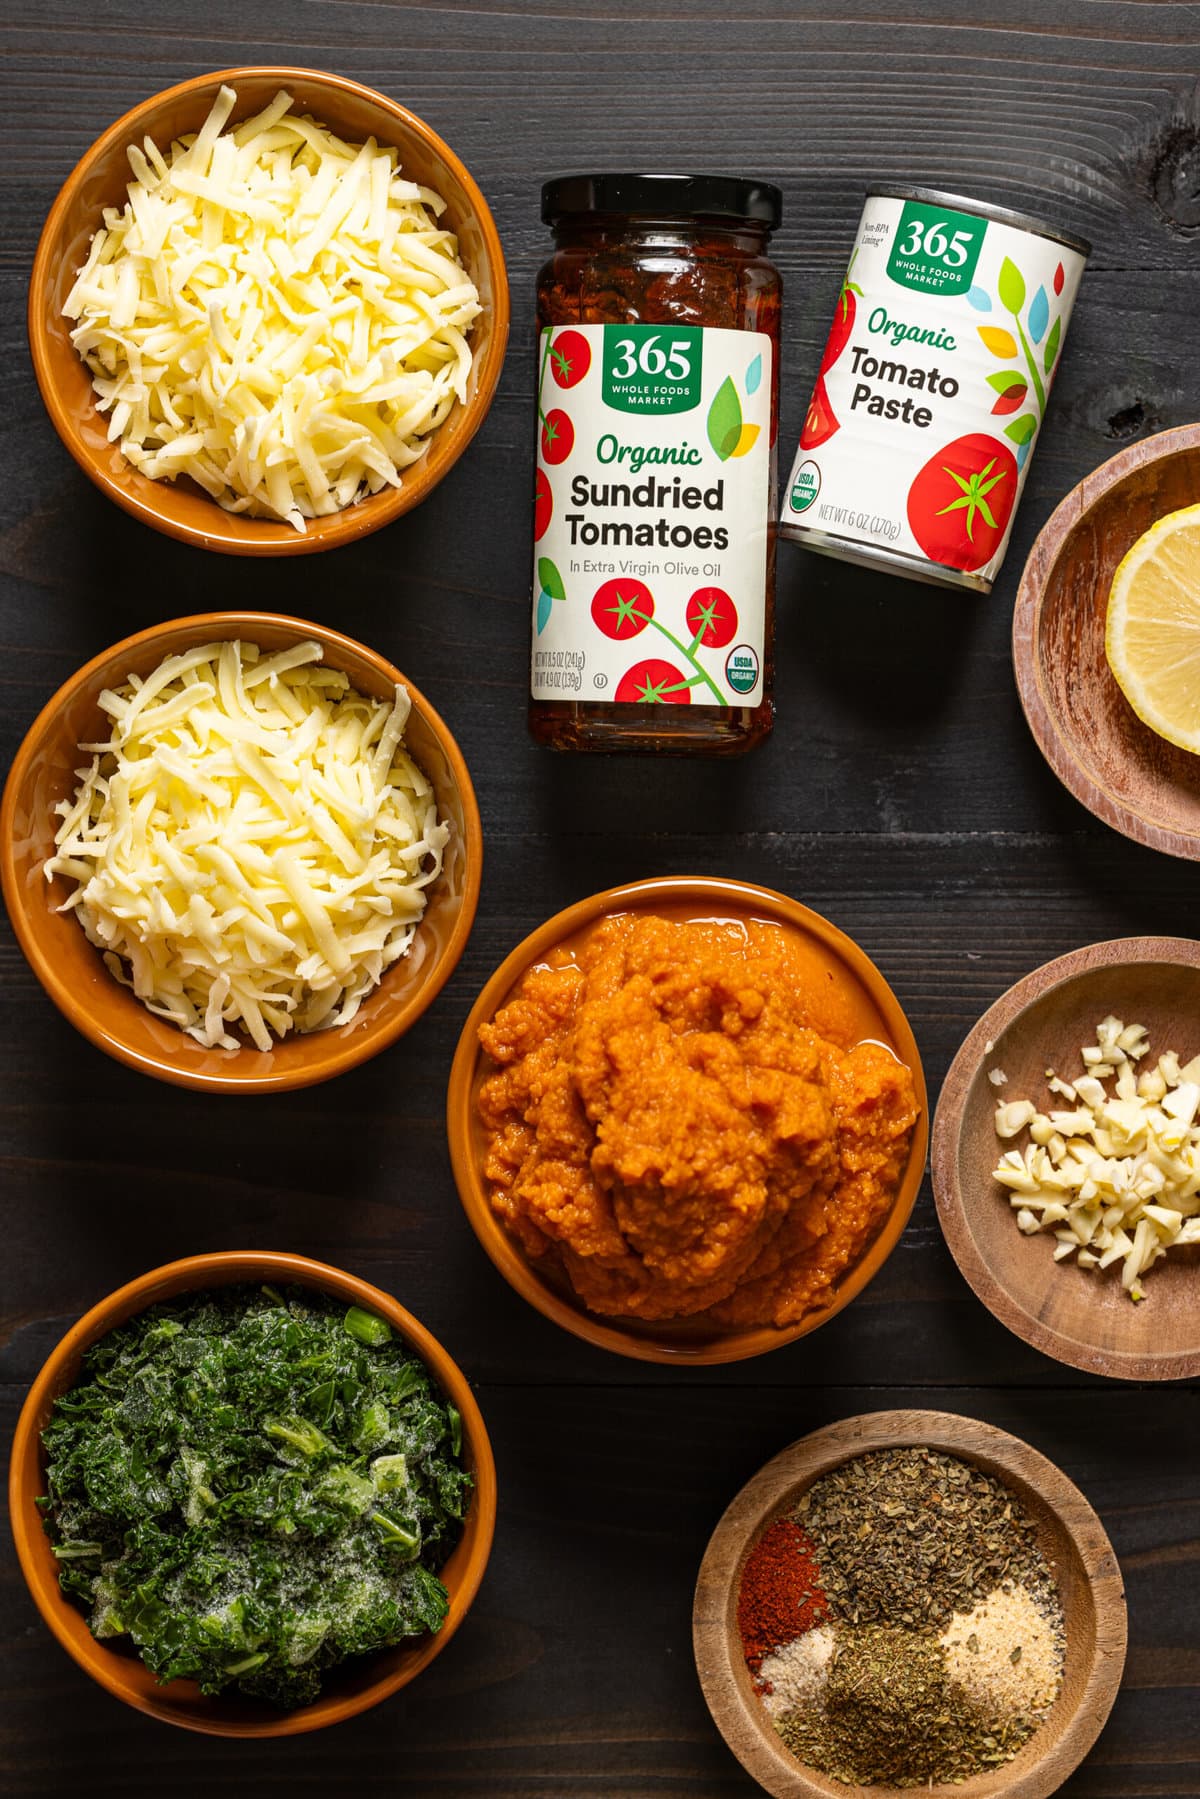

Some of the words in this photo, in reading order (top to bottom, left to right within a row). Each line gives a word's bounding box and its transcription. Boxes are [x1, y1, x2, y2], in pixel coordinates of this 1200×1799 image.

[899, 221, 974, 267] 365
[896, 260, 926, 273] WHOLE
[929, 268, 962, 282] FOODS
[905, 272, 944, 287] MARKET
[868, 307, 957, 351] Organic
[611, 335, 692, 381] 365
[851, 346, 959, 398] Tomato
[612, 385, 649, 394] WHOLE
[654, 386, 690, 396] FOODS
[628, 397, 673, 405] MARKET
[850, 383, 933, 428] Paste
[596, 434, 703, 474] Organic
[570, 475, 724, 511] Sundried
[798, 473, 814, 486] USDA
[565, 514, 729, 550] Tomatoes
[819, 504, 833, 521] NET
[833, 506, 848, 525] WT
[848, 511, 856, 527] 6
[856, 513, 870, 531] OZ
[870, 515, 902, 541] (170g)
[570, 560, 580, 573] In
[583, 561, 615, 573] Extra
[619, 561, 660, 577] Virgin
[664, 562, 699, 576] Olive
[703, 563, 721, 577] Oil
[564, 651, 586, 672] (241g)
[734, 656, 753, 668] USDA
[561, 672, 583, 692] (139g)
